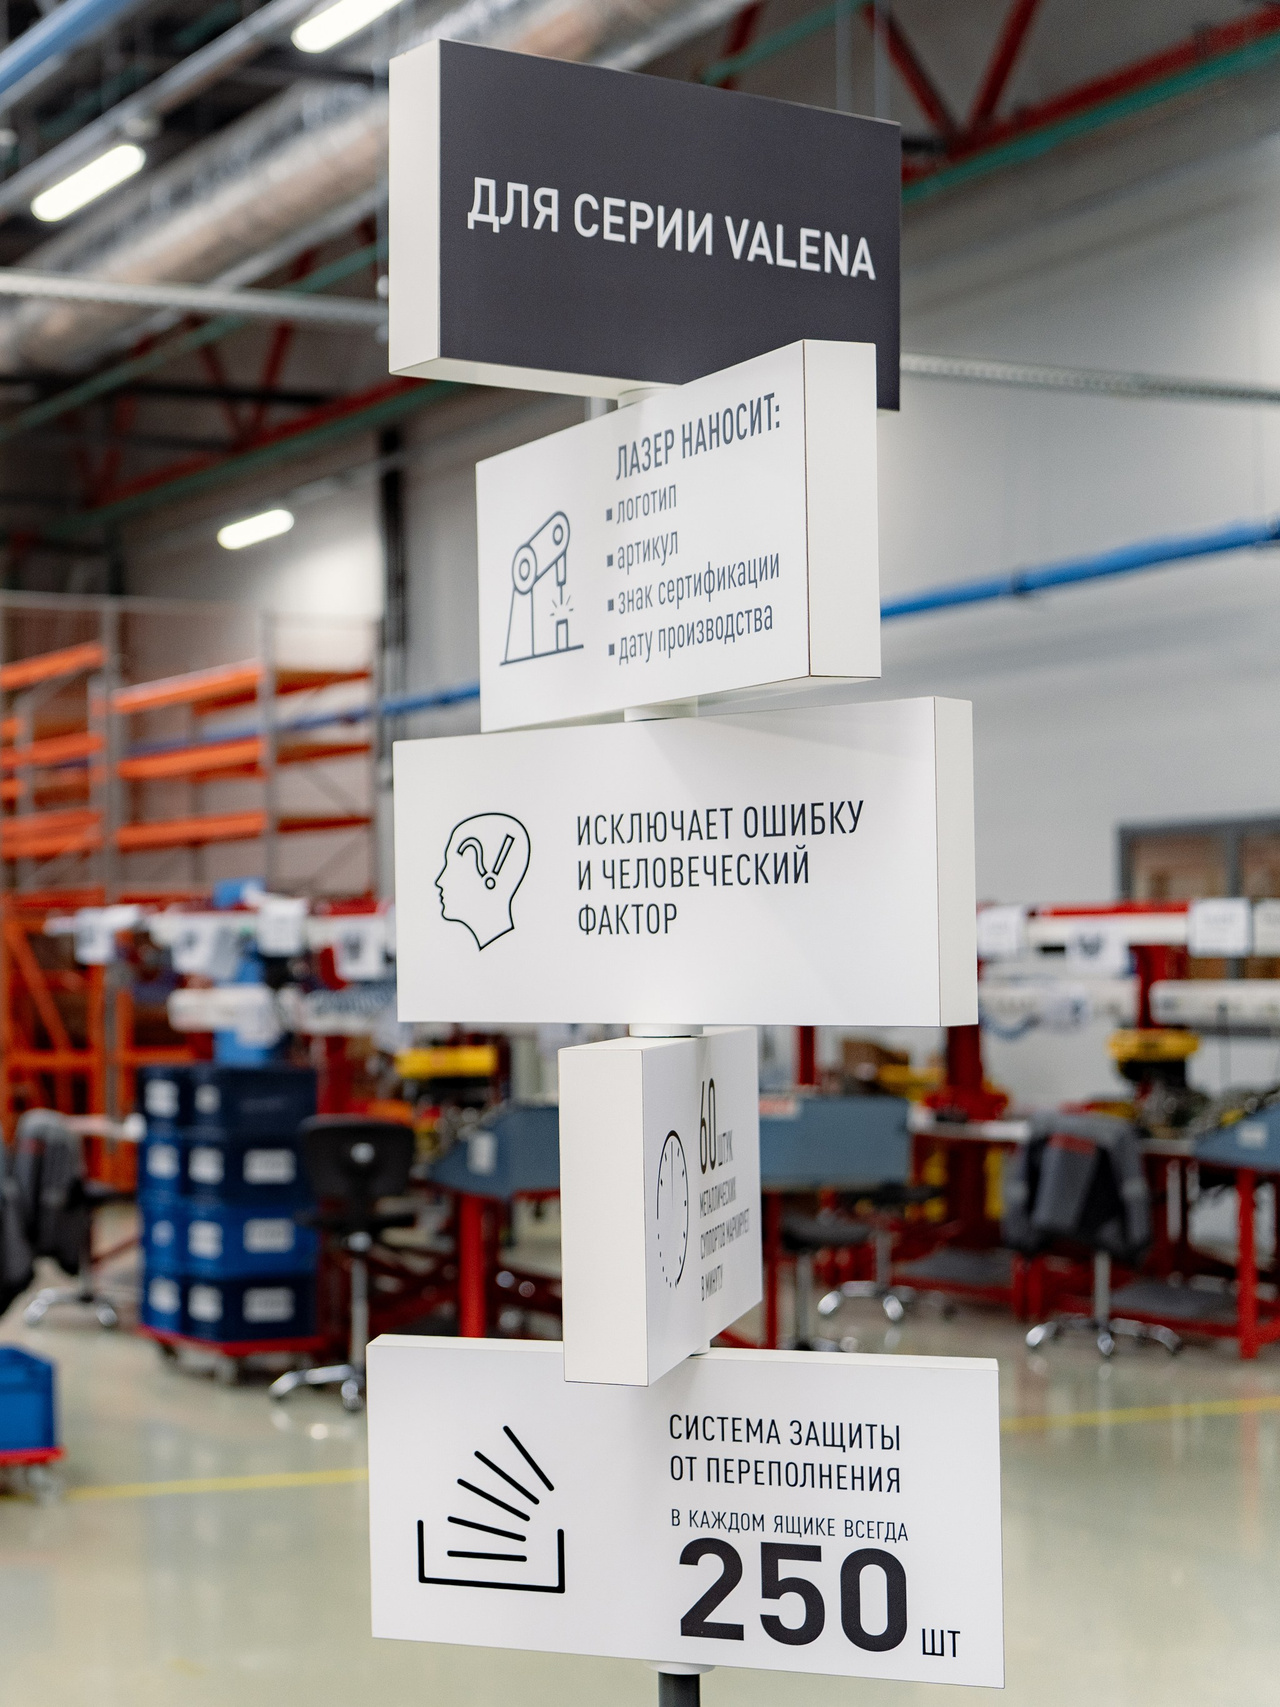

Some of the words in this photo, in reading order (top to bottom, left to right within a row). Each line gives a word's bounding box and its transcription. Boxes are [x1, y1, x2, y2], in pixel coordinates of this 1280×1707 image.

[466, 176, 559, 234] ДЛЯ
[573, 192, 714, 256] СЕРИИ
[724, 215, 877, 281] VALENA
[615, 428, 675, 481] ЛАЗЕР
[681, 391, 781, 460] НАНОСИТ:
[616, 483, 678, 525] логотип
[617, 530, 679, 575] артикул
[617, 584, 654, 616] знак
[657, 552, 781, 610] сертификации
[618, 630, 653, 666] дату
[657, 604, 774, 659] производства
[576, 806, 734, 847] ИСКЛЮЧАЕТ
[743, 799, 865, 839] ОШИБКУ
[577, 859, 592, 891] И
[601, 844, 810, 890] ЧЕЛОВЕЧЕСКИЙ
[576, 902, 678, 936] ФАКТОР
[699, 1077, 717, 1175] 60
[668, 1413, 782, 1445] СИСТЕМА
[789, 1419, 901, 1454] ЗАЩИТЫ
[669, 1454, 698, 1483] ОТ
[706, 1456, 901, 1494] ПЕРЕПОЛНЕНИЯ
[671, 1508, 681, 1527] В
[688, 1509, 765, 1533] КАЖДОМ
[773, 1514, 835, 1538] ЯЩИКЕ
[844, 1519, 909, 1544] ВСЕГДА
[678, 1536, 908, 1653] 250
